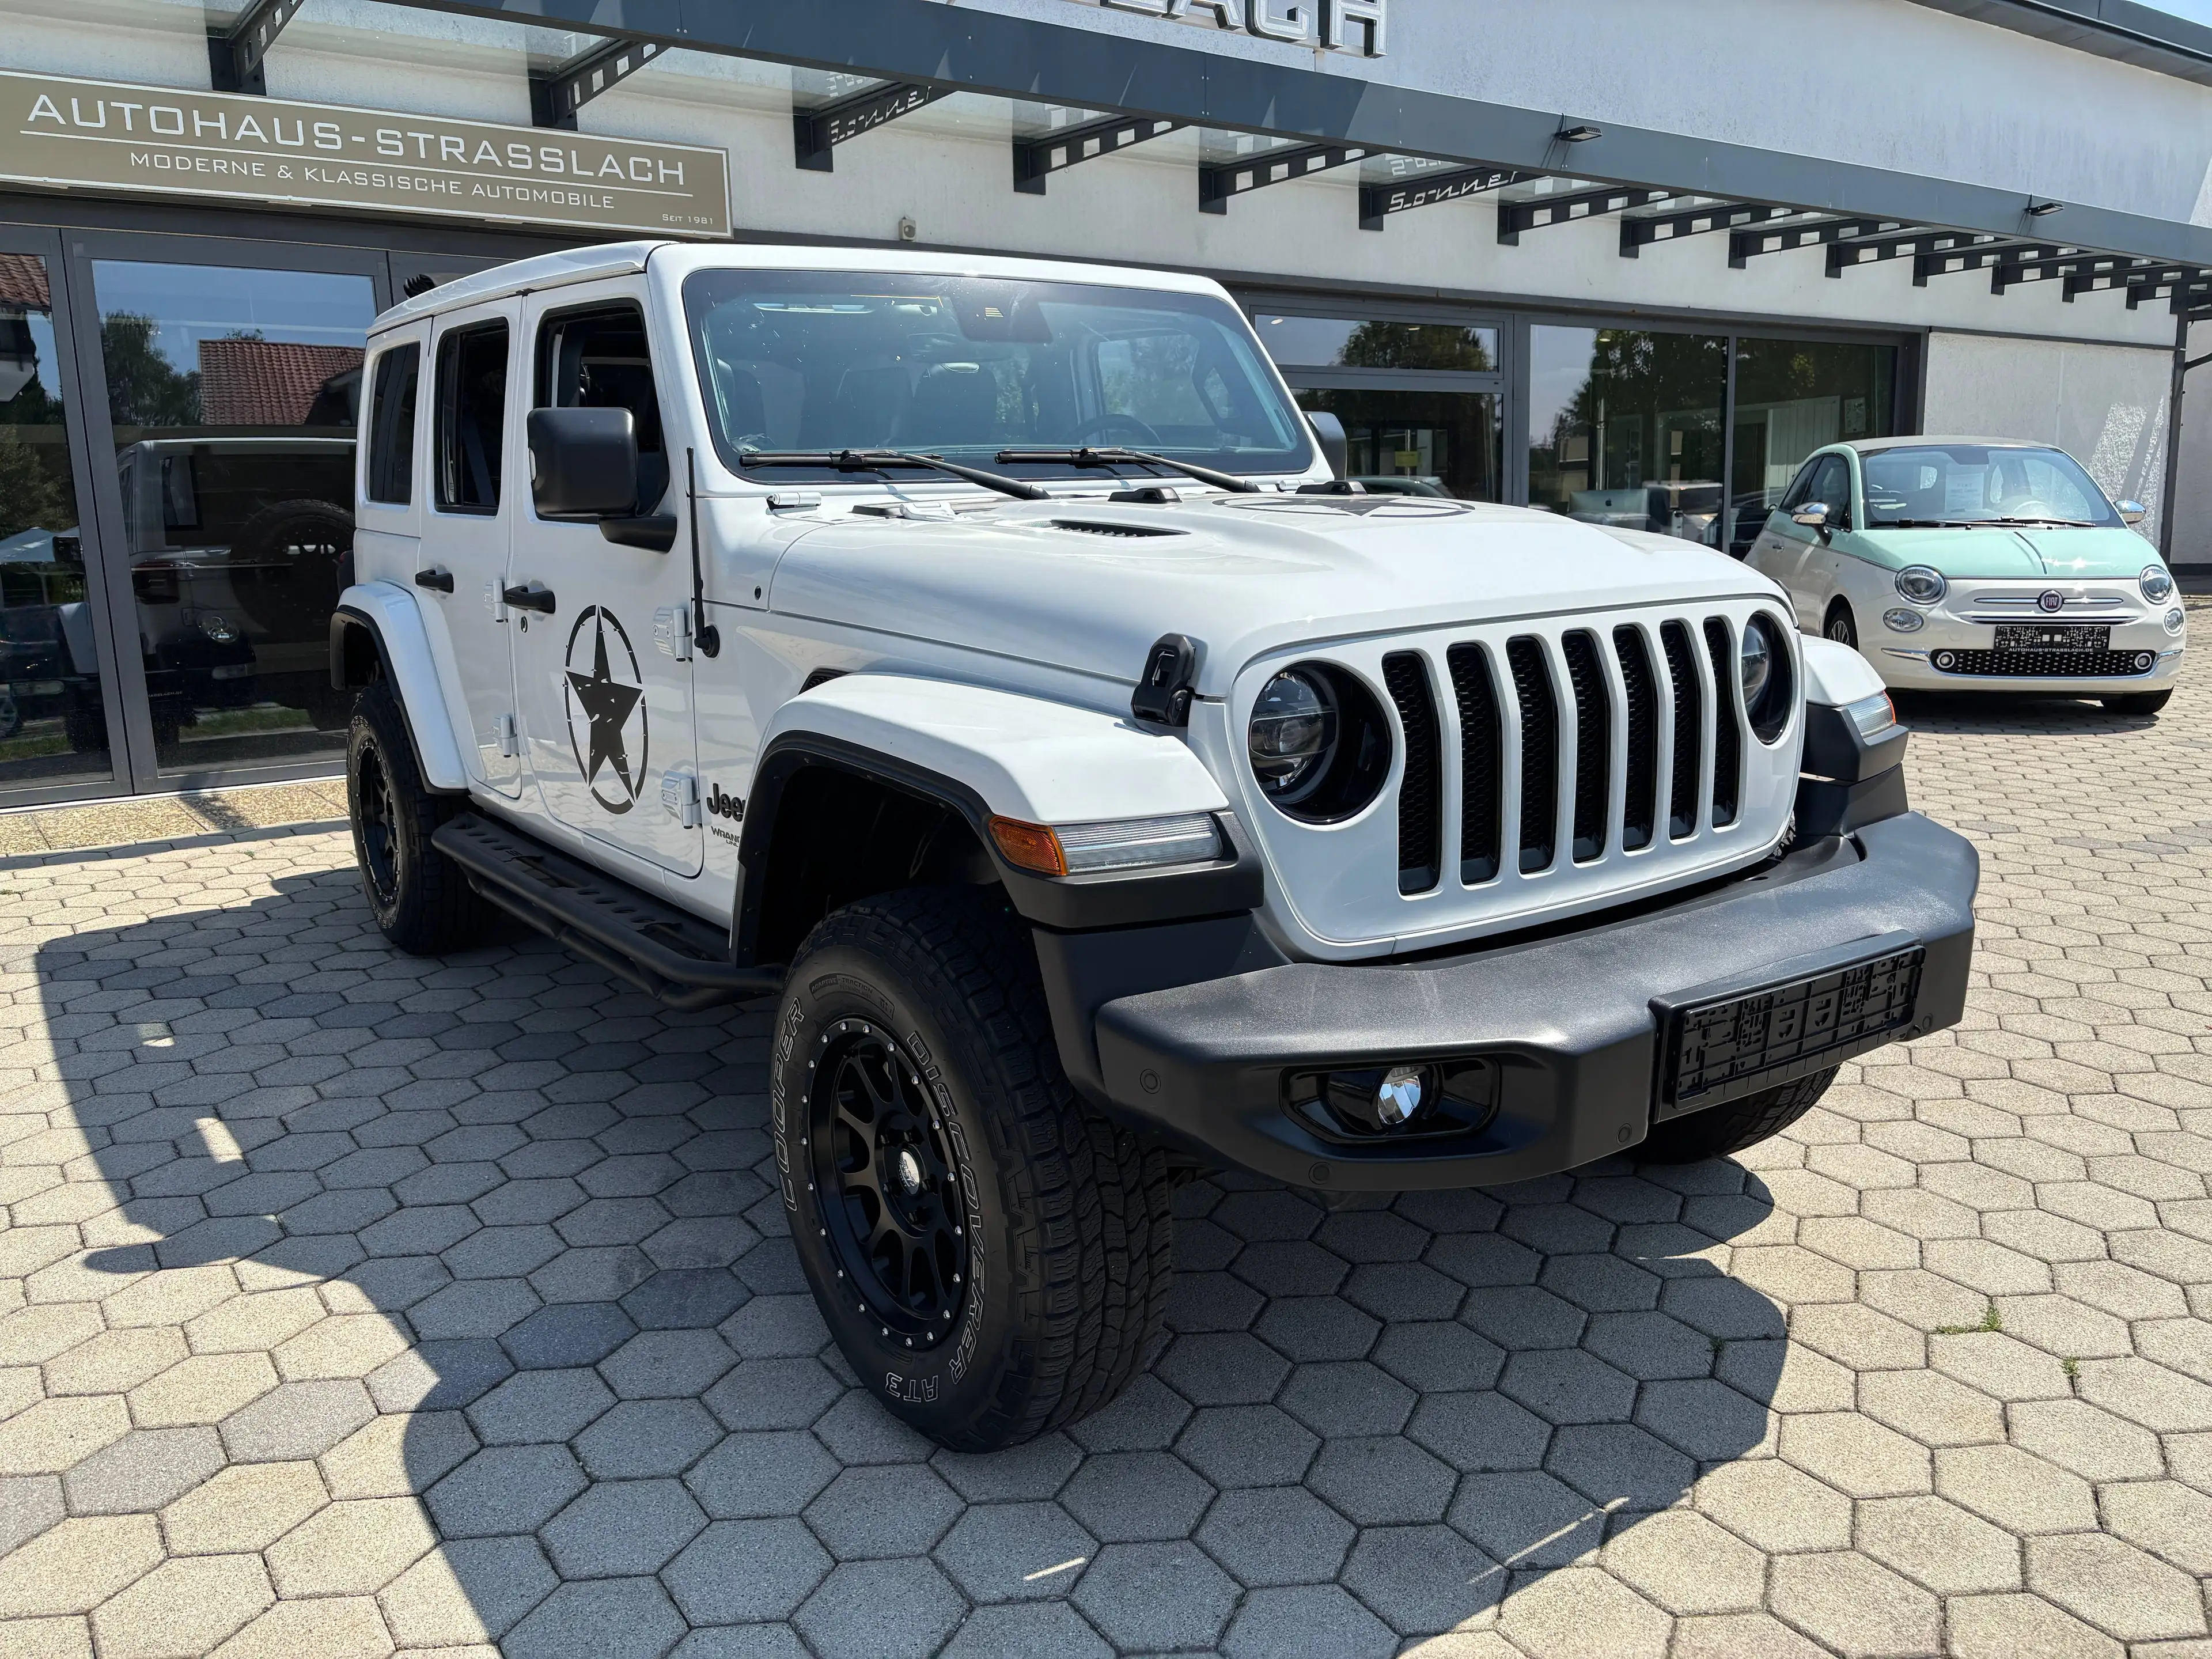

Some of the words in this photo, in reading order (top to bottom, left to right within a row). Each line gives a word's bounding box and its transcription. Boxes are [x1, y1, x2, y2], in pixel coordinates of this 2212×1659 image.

[27, 94, 684, 185] AUTOHAUS-STRASSLACH
[130, 152, 266, 177] MODERNE
[277, 165, 293, 179] &
[304, 167, 463, 195] KLASSISCHE
[472, 183, 615, 209] AUTOMOBILE
[688, 216, 713, 225] 1981
[2046, 597, 2058, 607] FIAT
[706, 783, 747, 822] Jee
[772, 997, 805, 1211] COOPER
[907, 1031, 986, 1385] DISCOVERER
[885, 1372, 938, 1403] AT3
